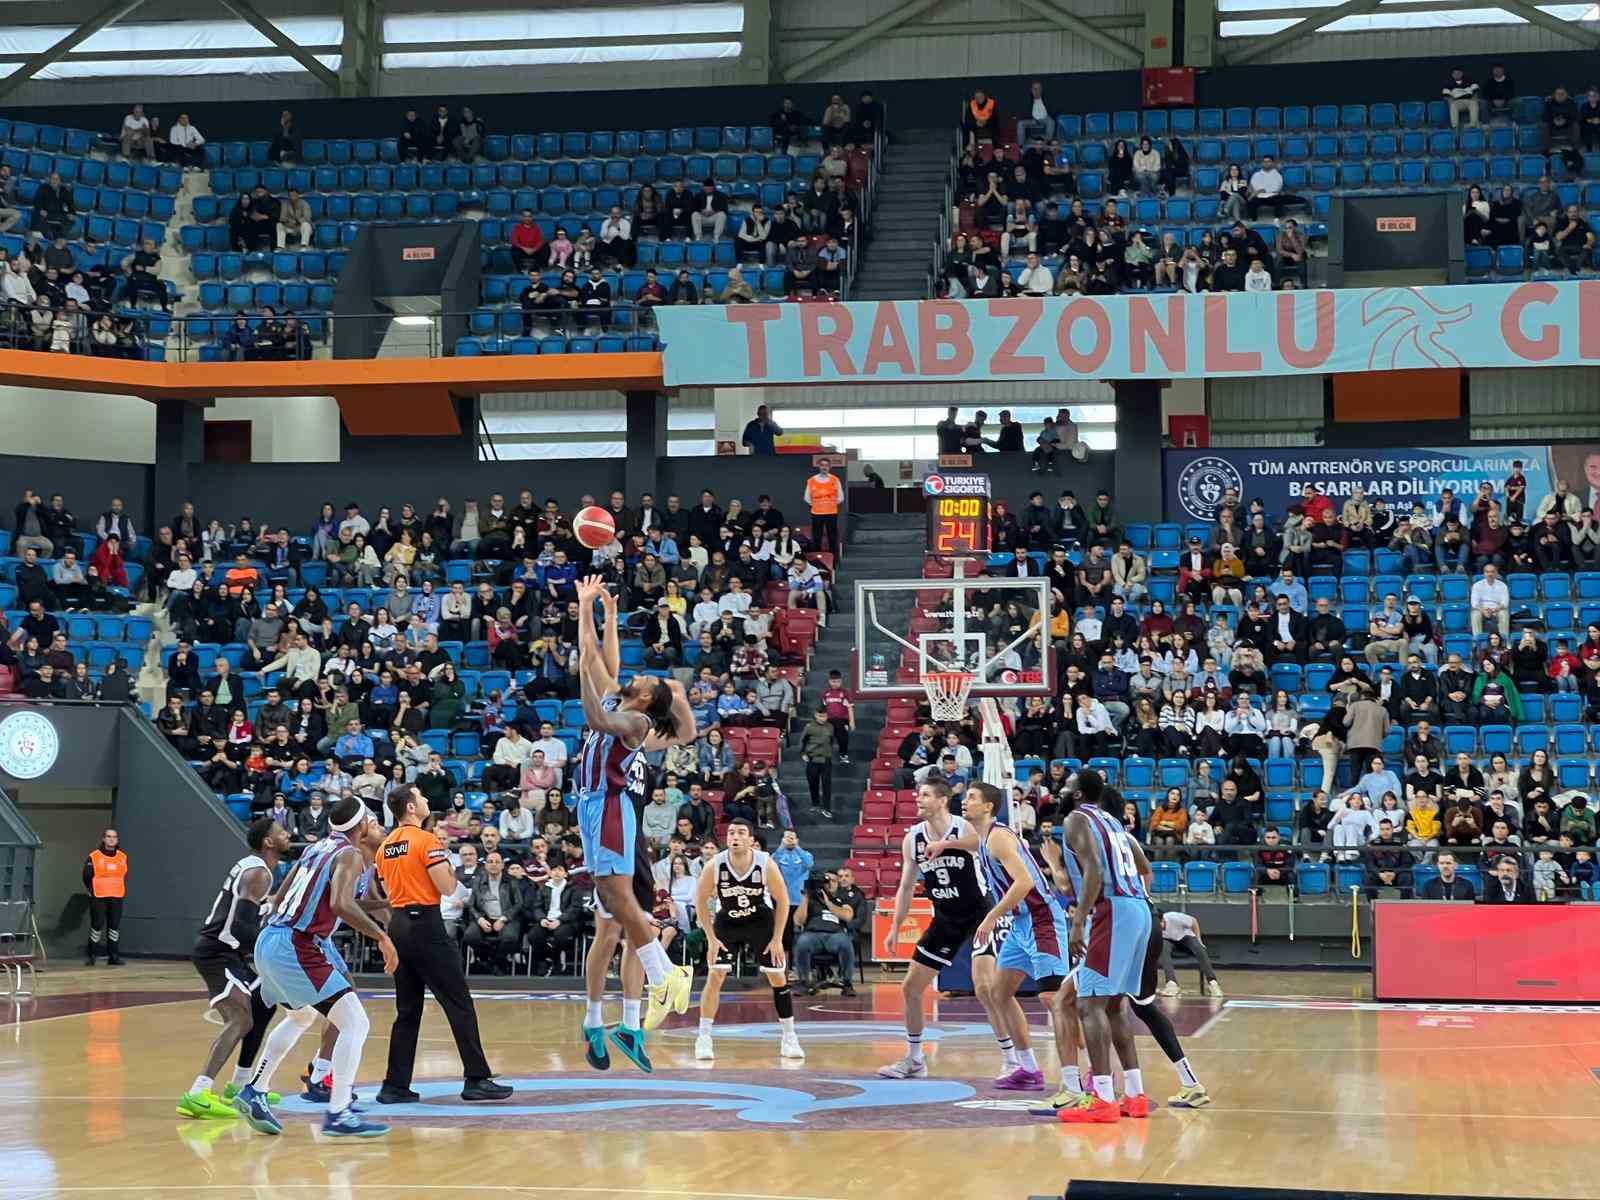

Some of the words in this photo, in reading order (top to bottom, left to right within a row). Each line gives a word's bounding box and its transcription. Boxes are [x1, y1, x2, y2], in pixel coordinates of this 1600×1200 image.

[725, 291, 1336, 378] TRABZONLU
[1249, 460, 1284, 475] TÜM
[1288, 459, 1373, 475] ANTRENÖR
[1375, 460, 1395, 474] VE
[1400, 458, 1541, 473] SPORCULARIMZA
[939, 499, 980, 517] 10:00
[939, 520, 977, 552] 24
[935, 868, 950, 885] 9
[931, 886, 960, 899] GAIN
